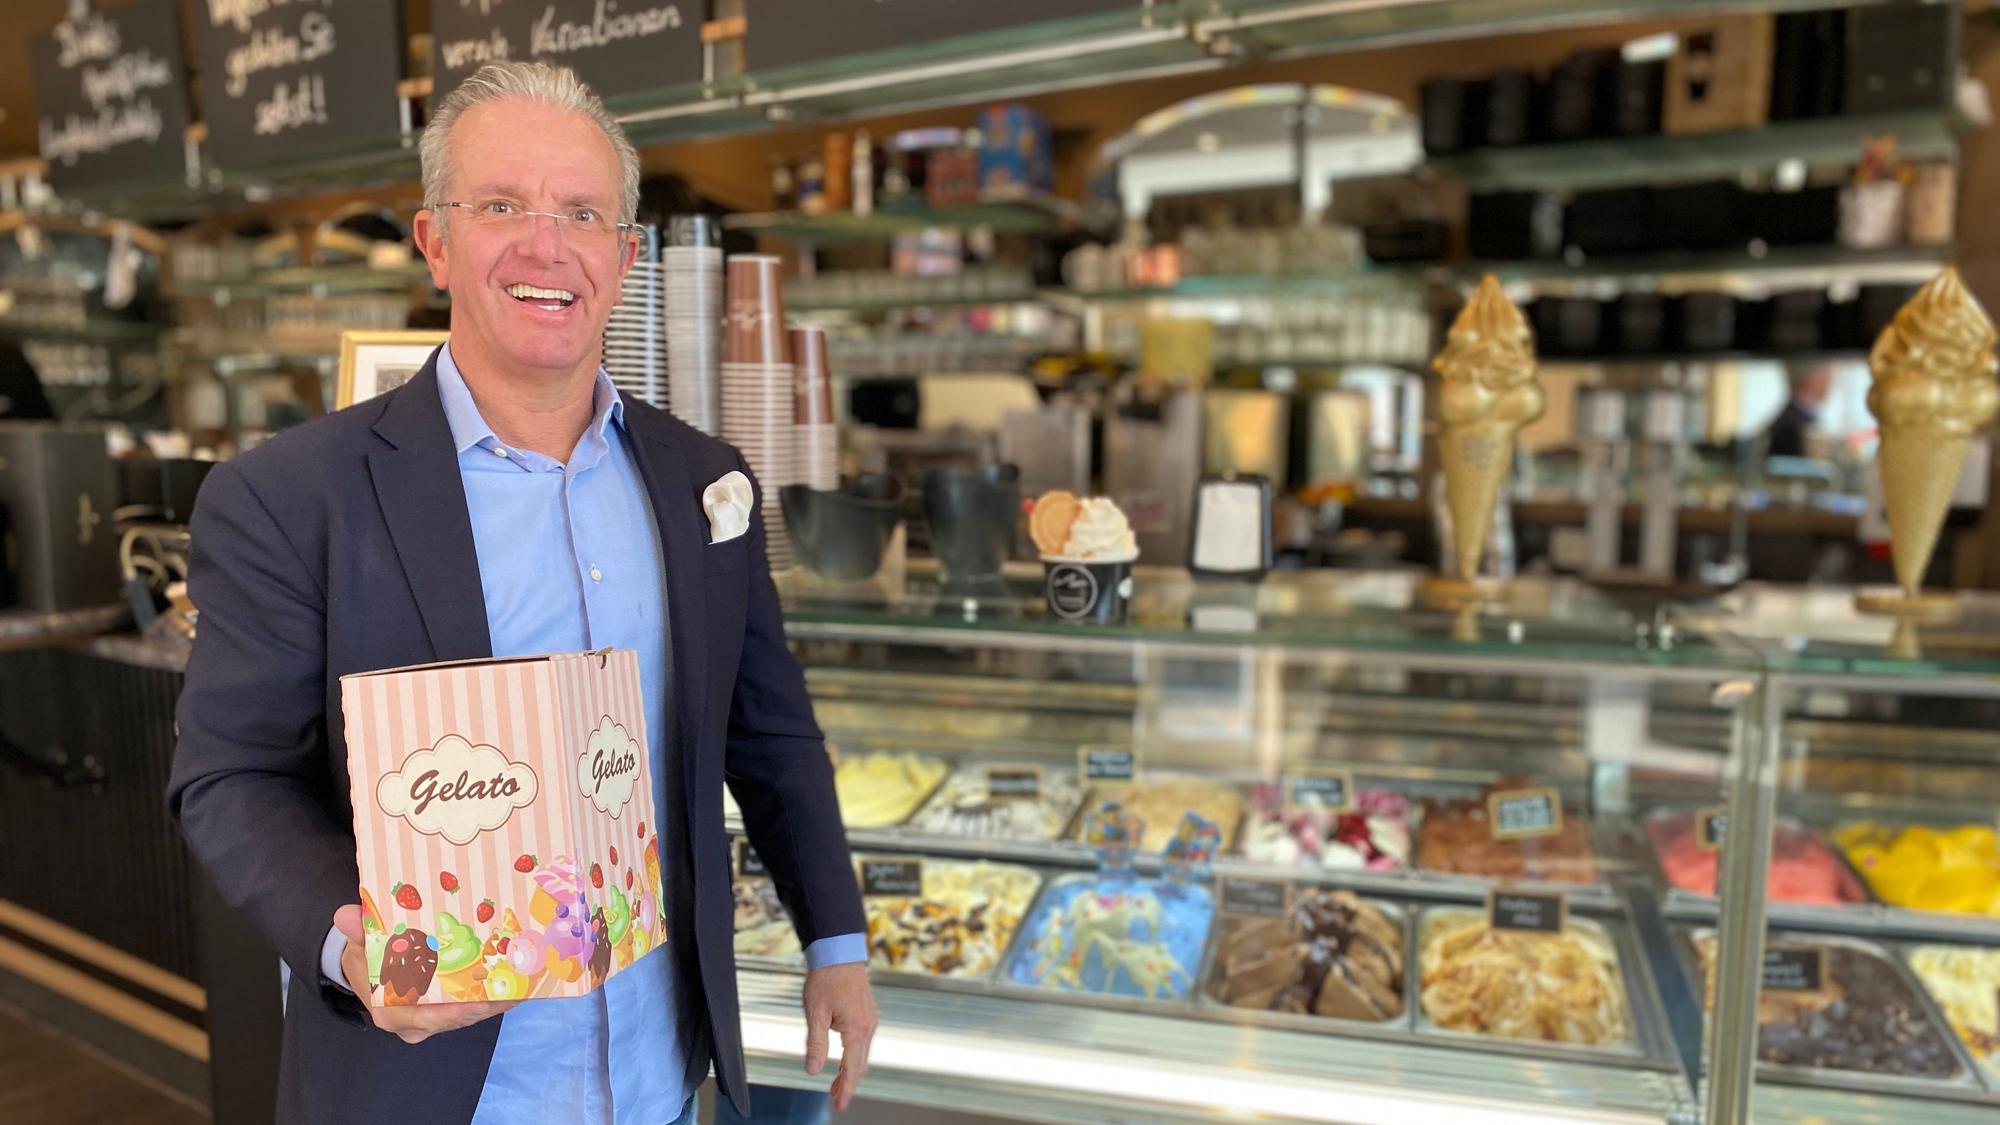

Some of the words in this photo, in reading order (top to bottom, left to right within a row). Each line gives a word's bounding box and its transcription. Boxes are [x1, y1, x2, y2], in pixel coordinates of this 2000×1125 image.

[530, 0, 683, 55] Variationen
[409, 769, 521, 816] Gelato
[592, 748, 636, 794] Gelato
